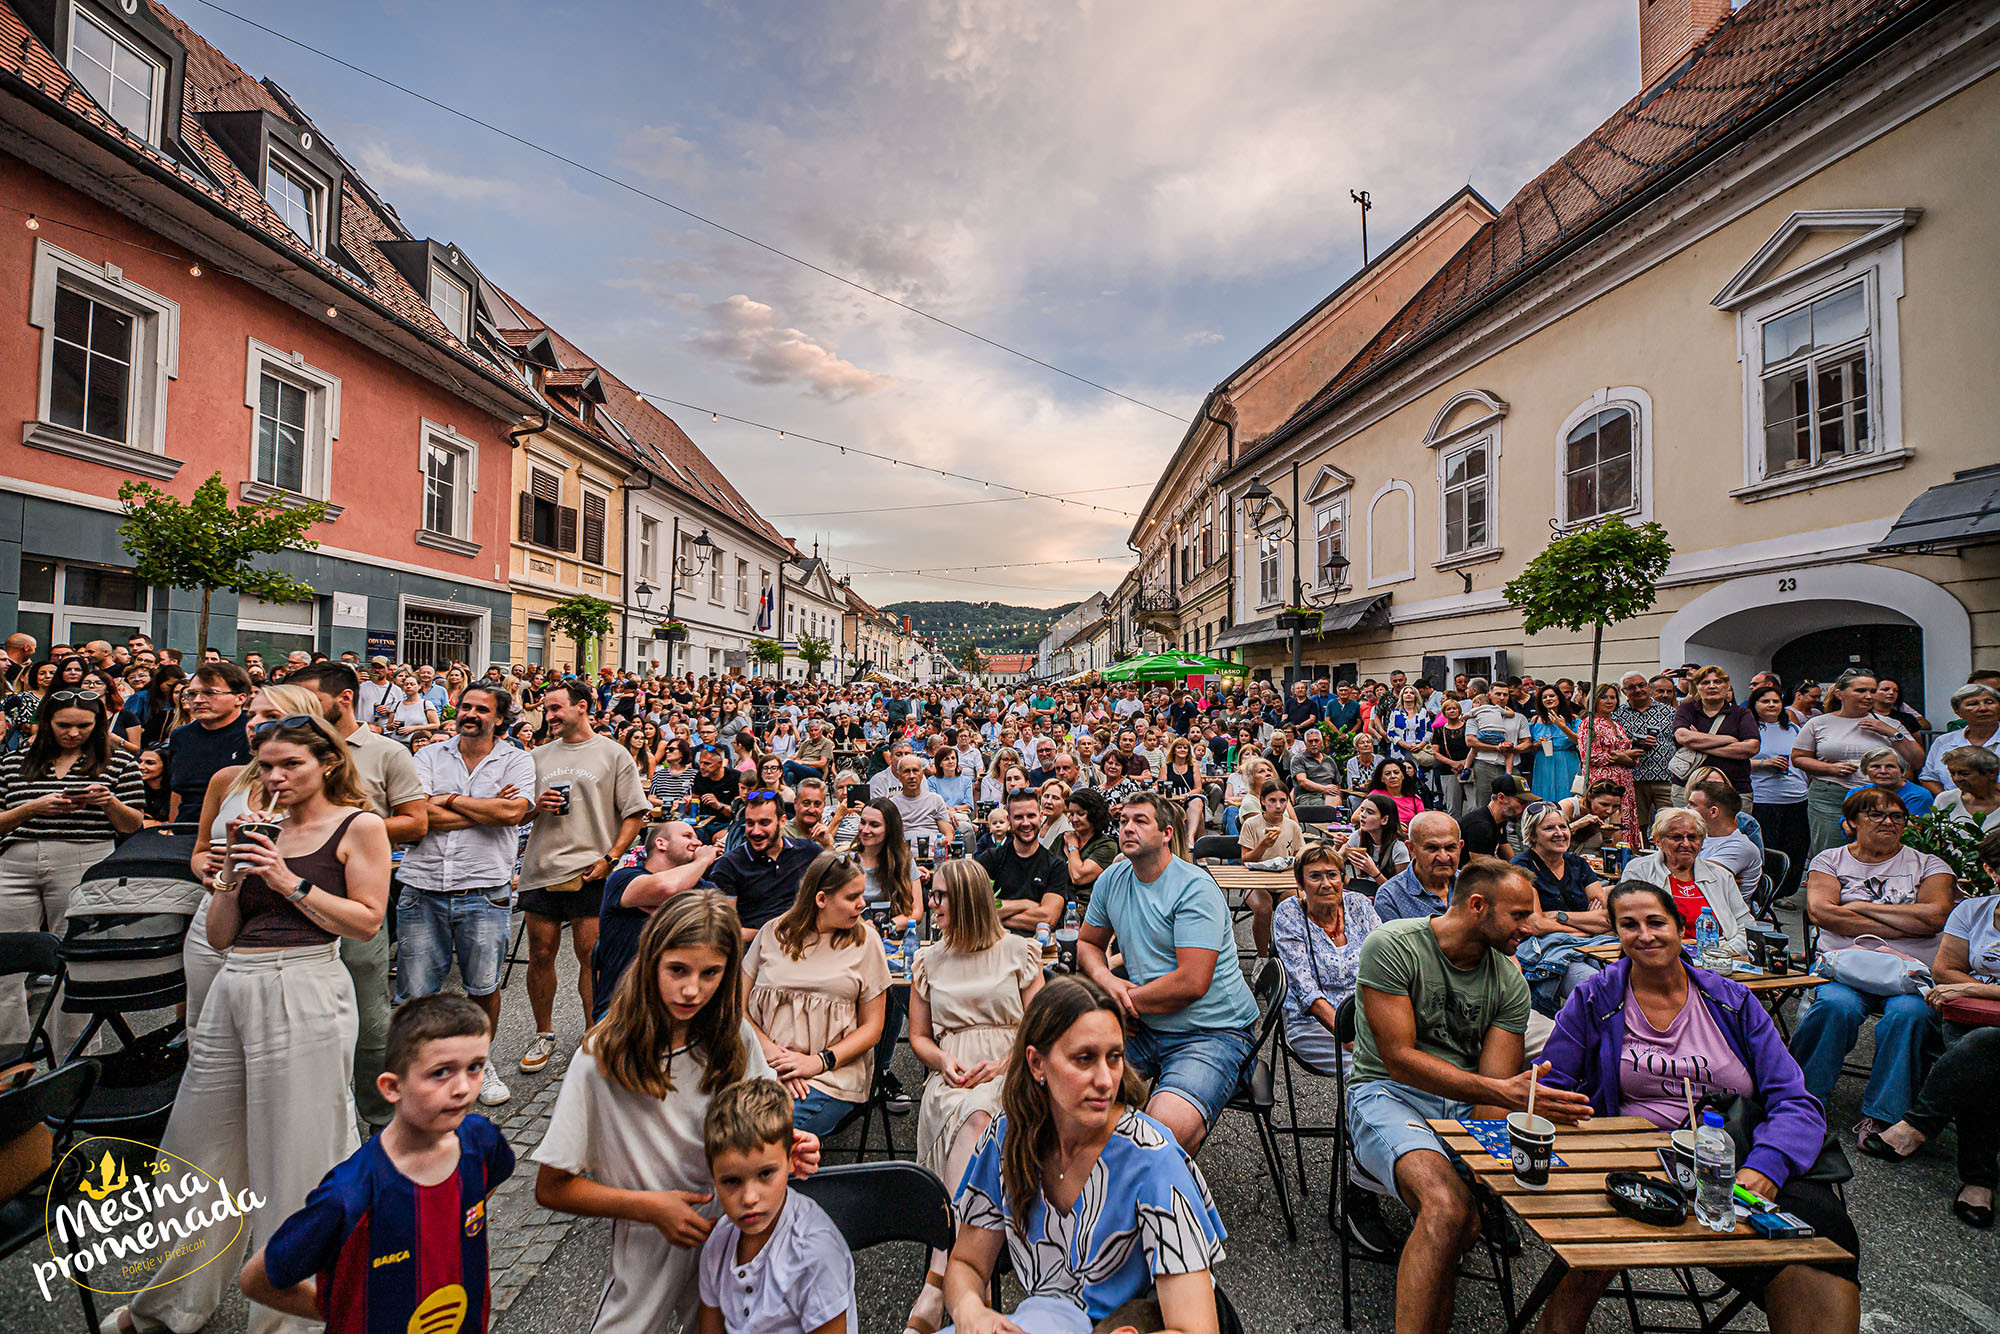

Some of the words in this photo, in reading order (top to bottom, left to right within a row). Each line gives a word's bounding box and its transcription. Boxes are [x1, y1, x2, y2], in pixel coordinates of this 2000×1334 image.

[301, 132, 313, 150] 0
[450, 251, 459, 266] 2
[1778, 577, 1797, 592] 23
[1630, 1048, 1714, 1084] YOUR
